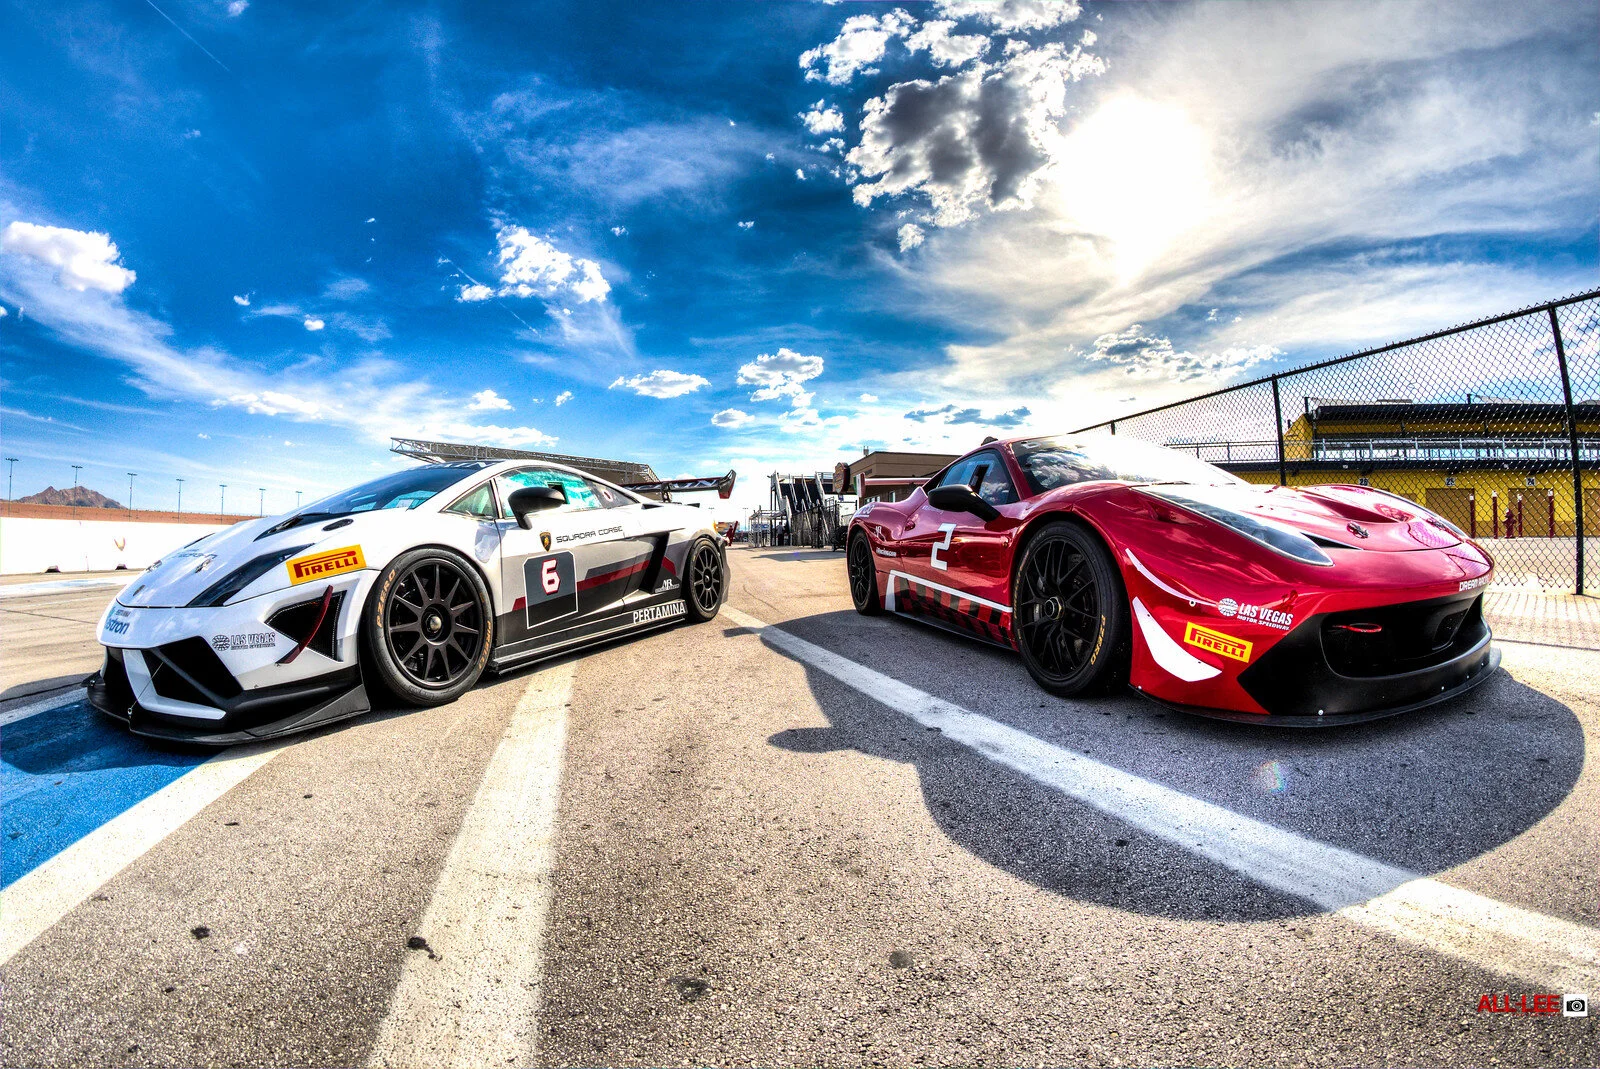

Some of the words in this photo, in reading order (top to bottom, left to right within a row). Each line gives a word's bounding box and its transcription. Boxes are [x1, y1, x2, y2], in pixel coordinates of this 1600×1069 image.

[556, 531, 596, 543] SQUADRA
[598, 526, 623, 536] CORSE
[931, 523, 957, 571] 2
[293, 550, 358, 578] PIRELLI
[541, 560, 560, 594] 6
[633, 602, 686, 624] PERTAMINA
[1237, 615, 1258, 624] MOTOR
[1238, 603, 1259, 618] LAS
[1260, 608, 1294, 626] VEGAS
[231, 635, 246, 645] LAS
[248, 632, 276, 644] VEGAS
[1190, 628, 1247, 658] PIRELLI
